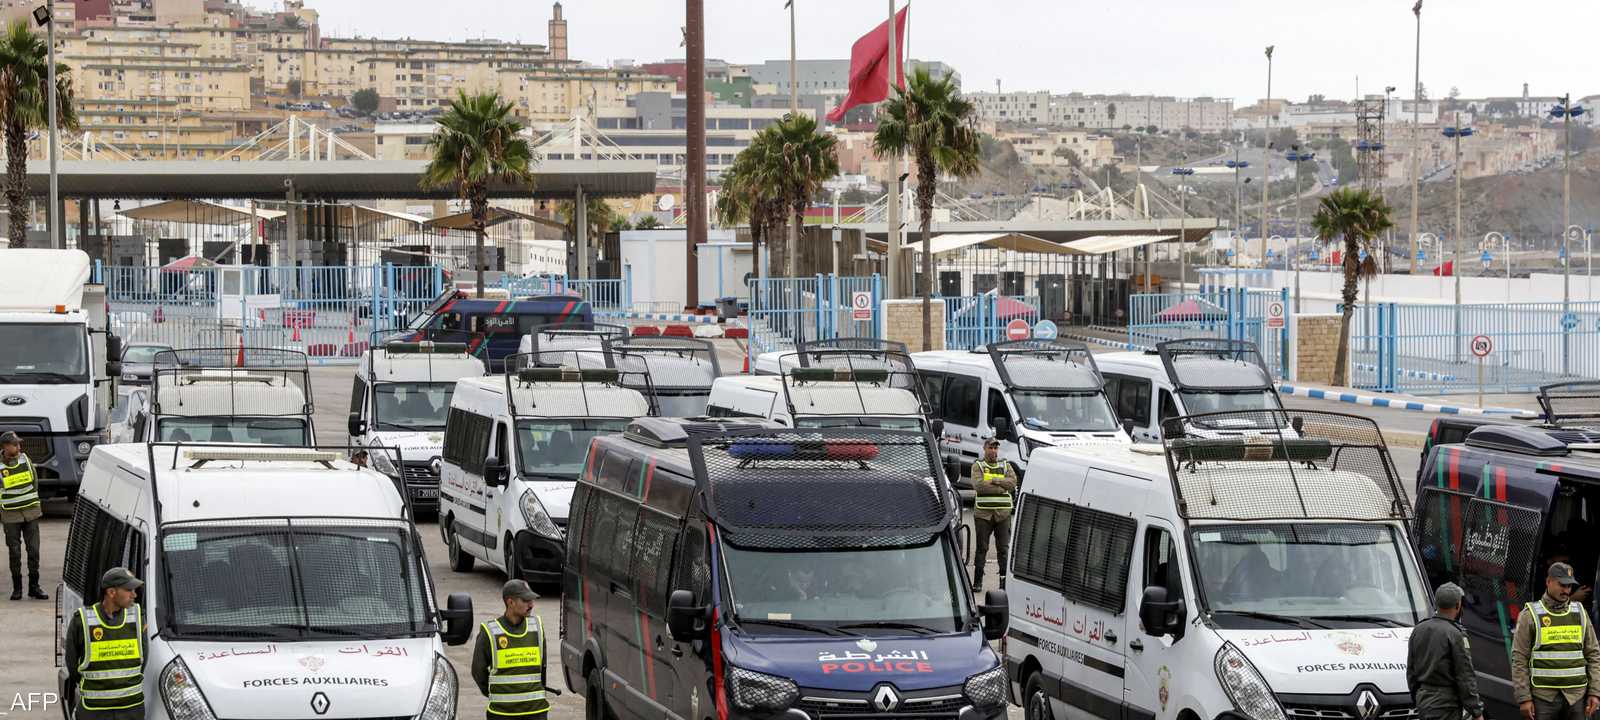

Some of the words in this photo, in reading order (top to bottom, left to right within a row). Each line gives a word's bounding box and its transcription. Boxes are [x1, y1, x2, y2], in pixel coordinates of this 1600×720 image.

[1025, 596, 1067, 627] المساعدة
[1073, 615, 1105, 644] القوات
[1241, 631, 1312, 647] المساعدة
[197, 644, 277, 661] المساعدة
[337, 644, 408, 657] القوات
[1038, 638, 1056, 655] FORCES
[818, 649, 929, 662] الشرطة
[821, 661, 934, 674] POLICE
[1296, 663, 1346, 673] FORCES
[1348, 662, 1407, 671] AUXILIAIR
[243, 677, 298, 688] FORCES
[301, 677, 389, 687] AUXILIAIRES
